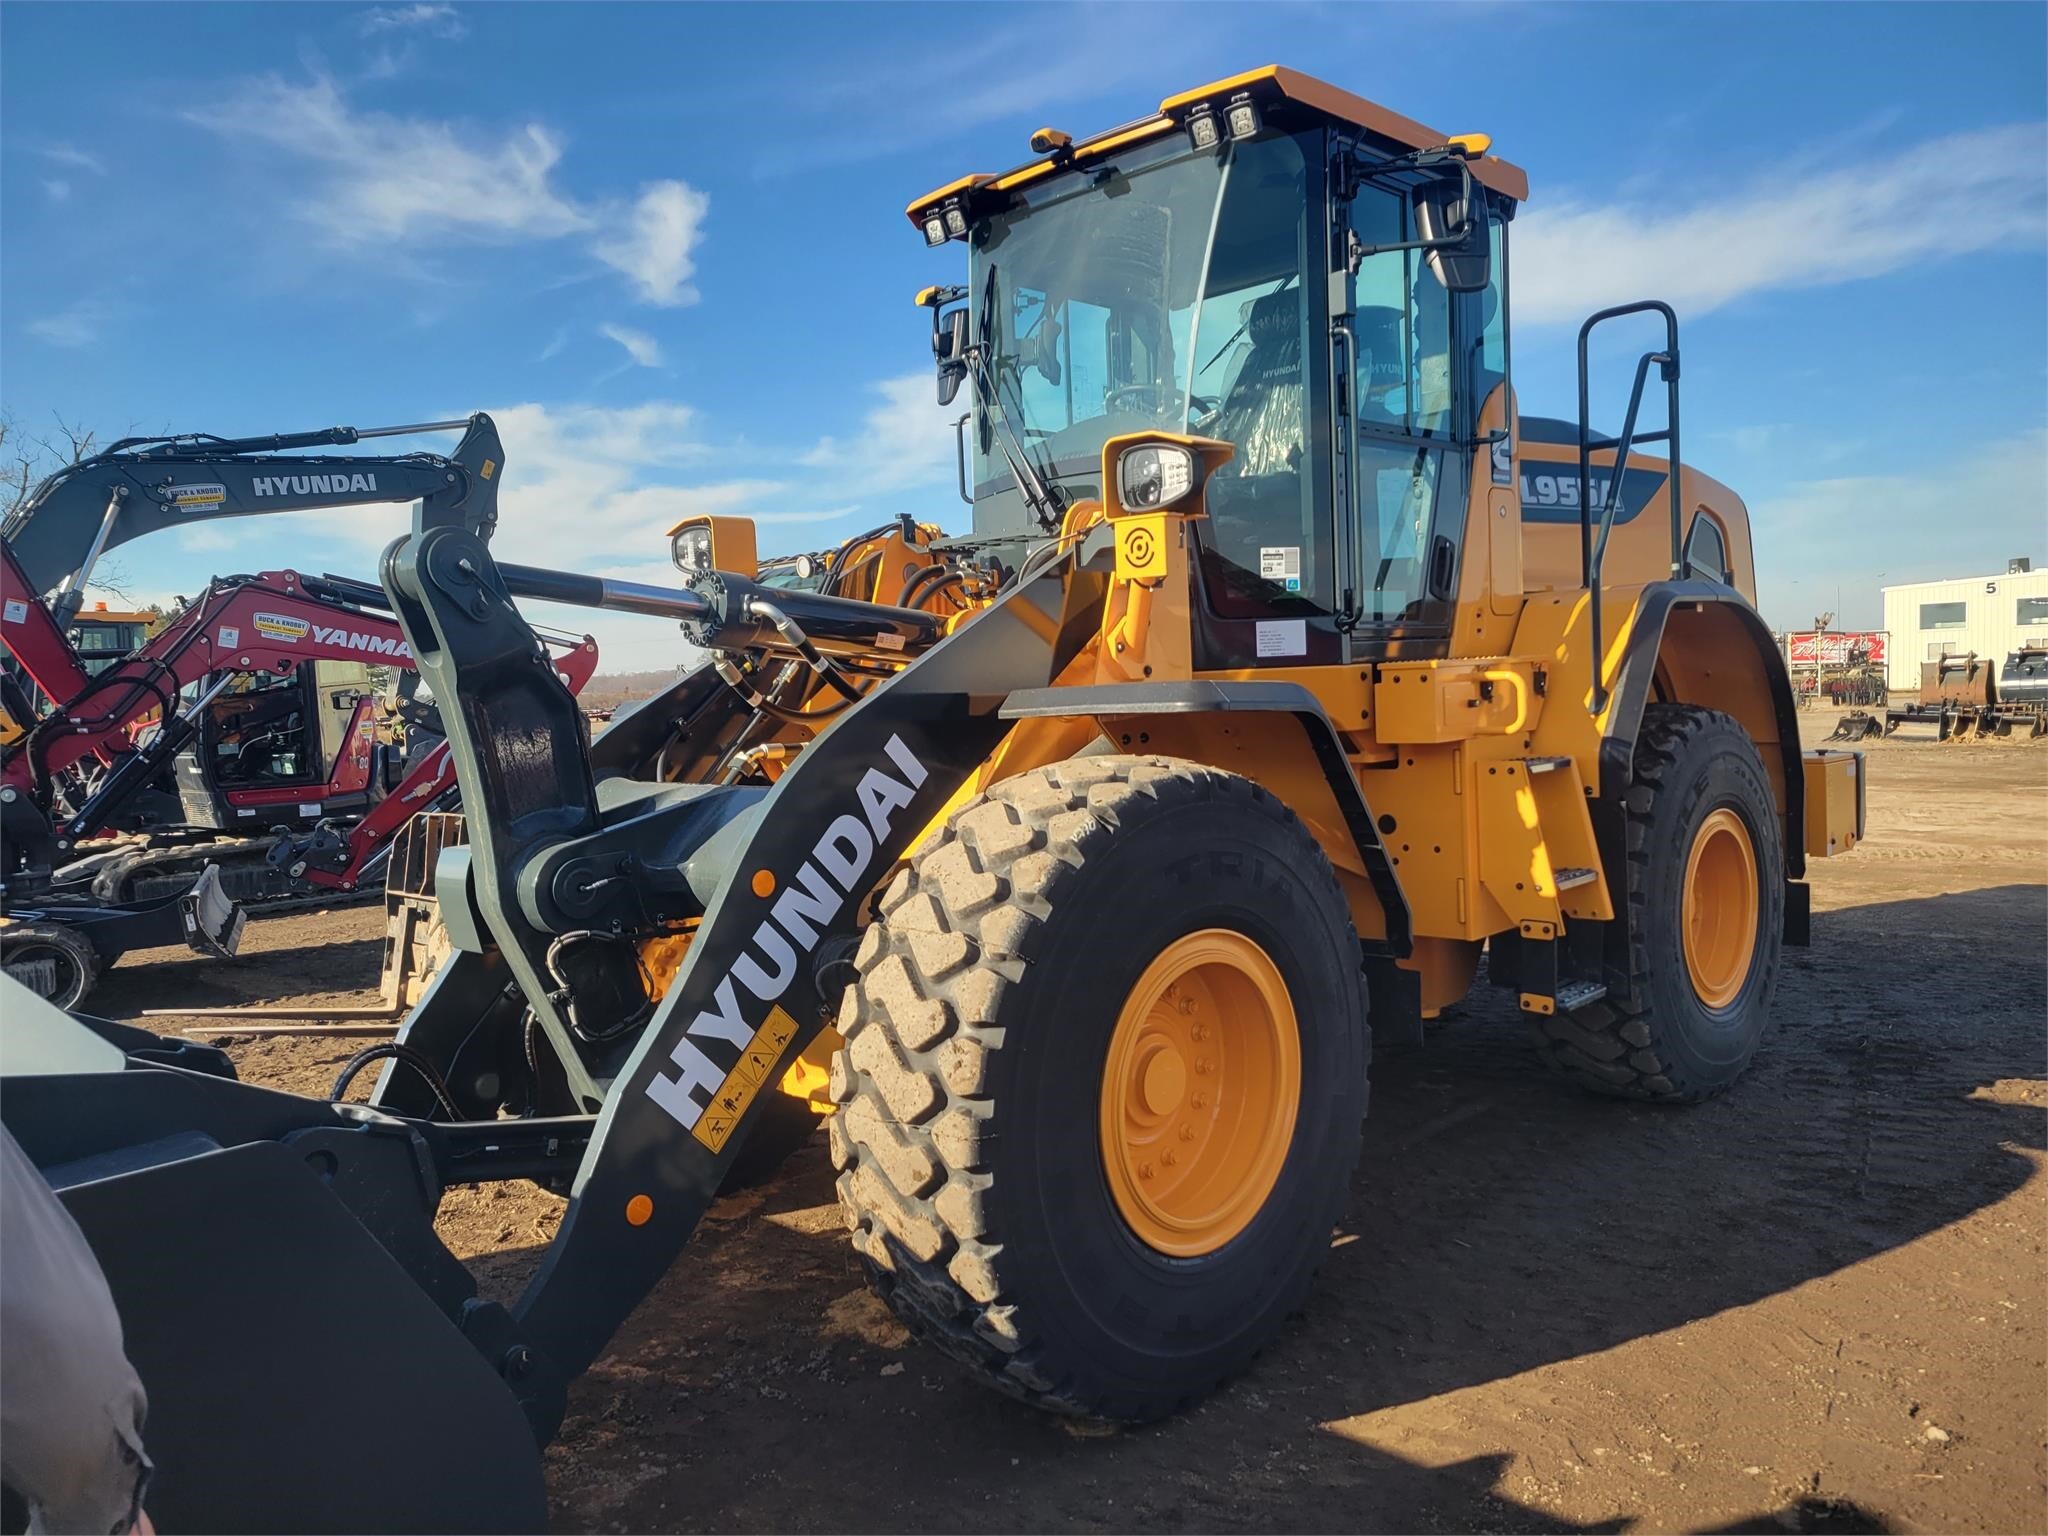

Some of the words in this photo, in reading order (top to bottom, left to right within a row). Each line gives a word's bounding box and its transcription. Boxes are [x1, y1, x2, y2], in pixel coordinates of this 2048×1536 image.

[252, 473, 377, 496] HYUNDAI
[1986, 582, 1997, 594] 5
[258, 615, 275, 624] BUCK
[281, 620, 306, 629] KNOBBY
[312, 624, 413, 659] YANMA
[645, 733, 929, 1131] HYUNDAI
